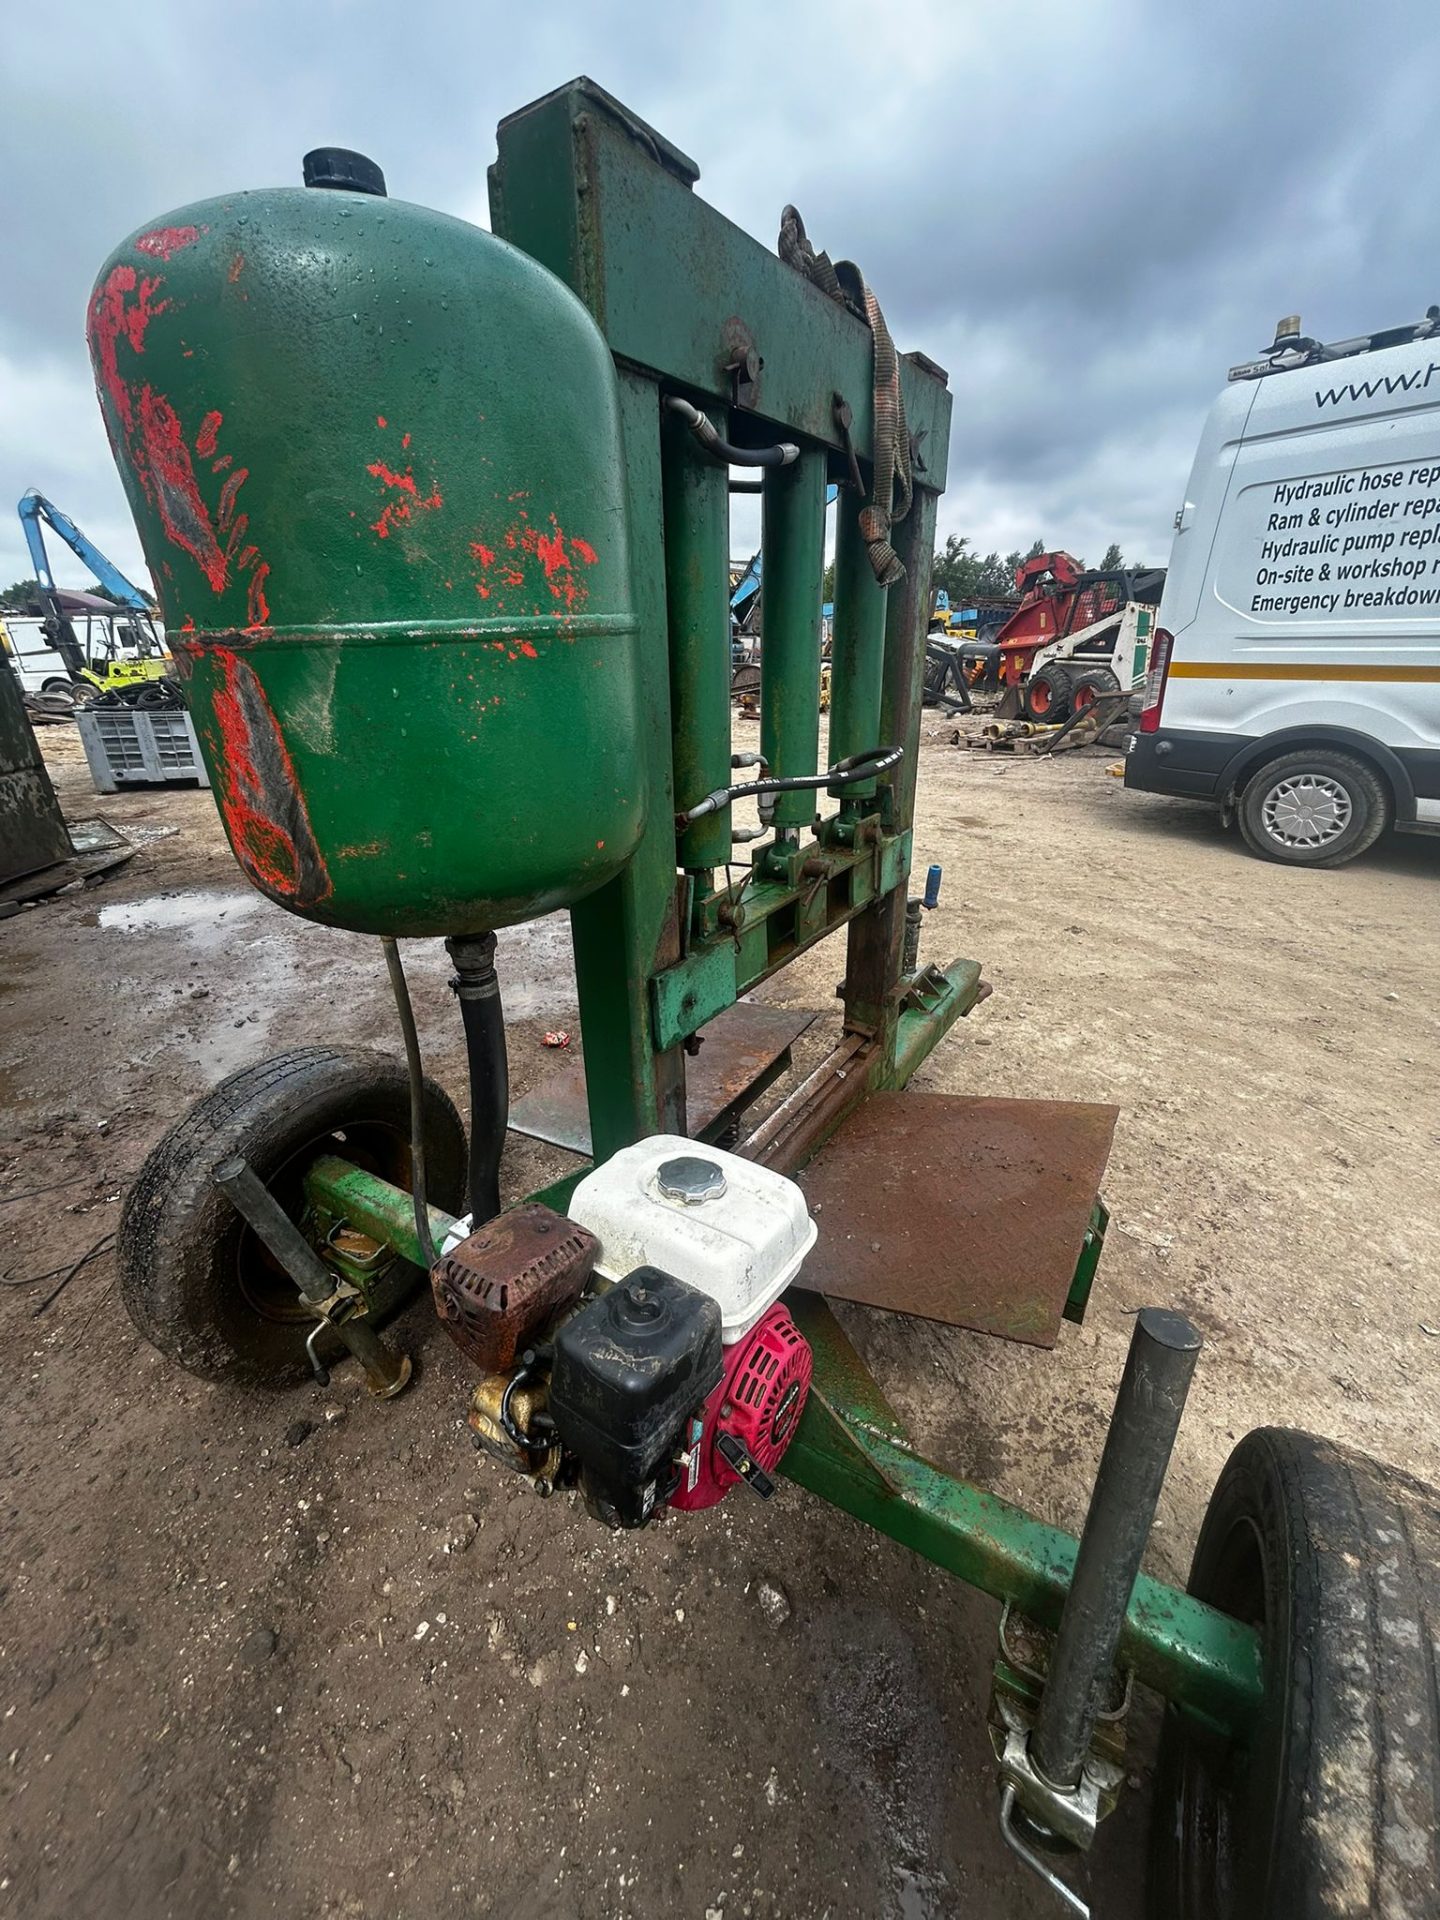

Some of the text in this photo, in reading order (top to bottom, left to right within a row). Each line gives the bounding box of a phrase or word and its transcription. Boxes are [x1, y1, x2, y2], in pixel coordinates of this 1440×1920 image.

[1273, 474, 1355, 506] Hydraulic
[1358, 471, 1403, 492] hose
[1267, 513, 1303, 531] Ram
[1308, 507, 1321, 527] &
[1326, 499, 1400, 528] cylinder
[1261, 523, 1440, 562] Hydraulic pump repl
[1256, 565, 1314, 586] On-site
[1318, 563, 1331, 582] &
[1337, 557, 1426, 580] workshop
[1251, 594, 1340, 614] Emergency
